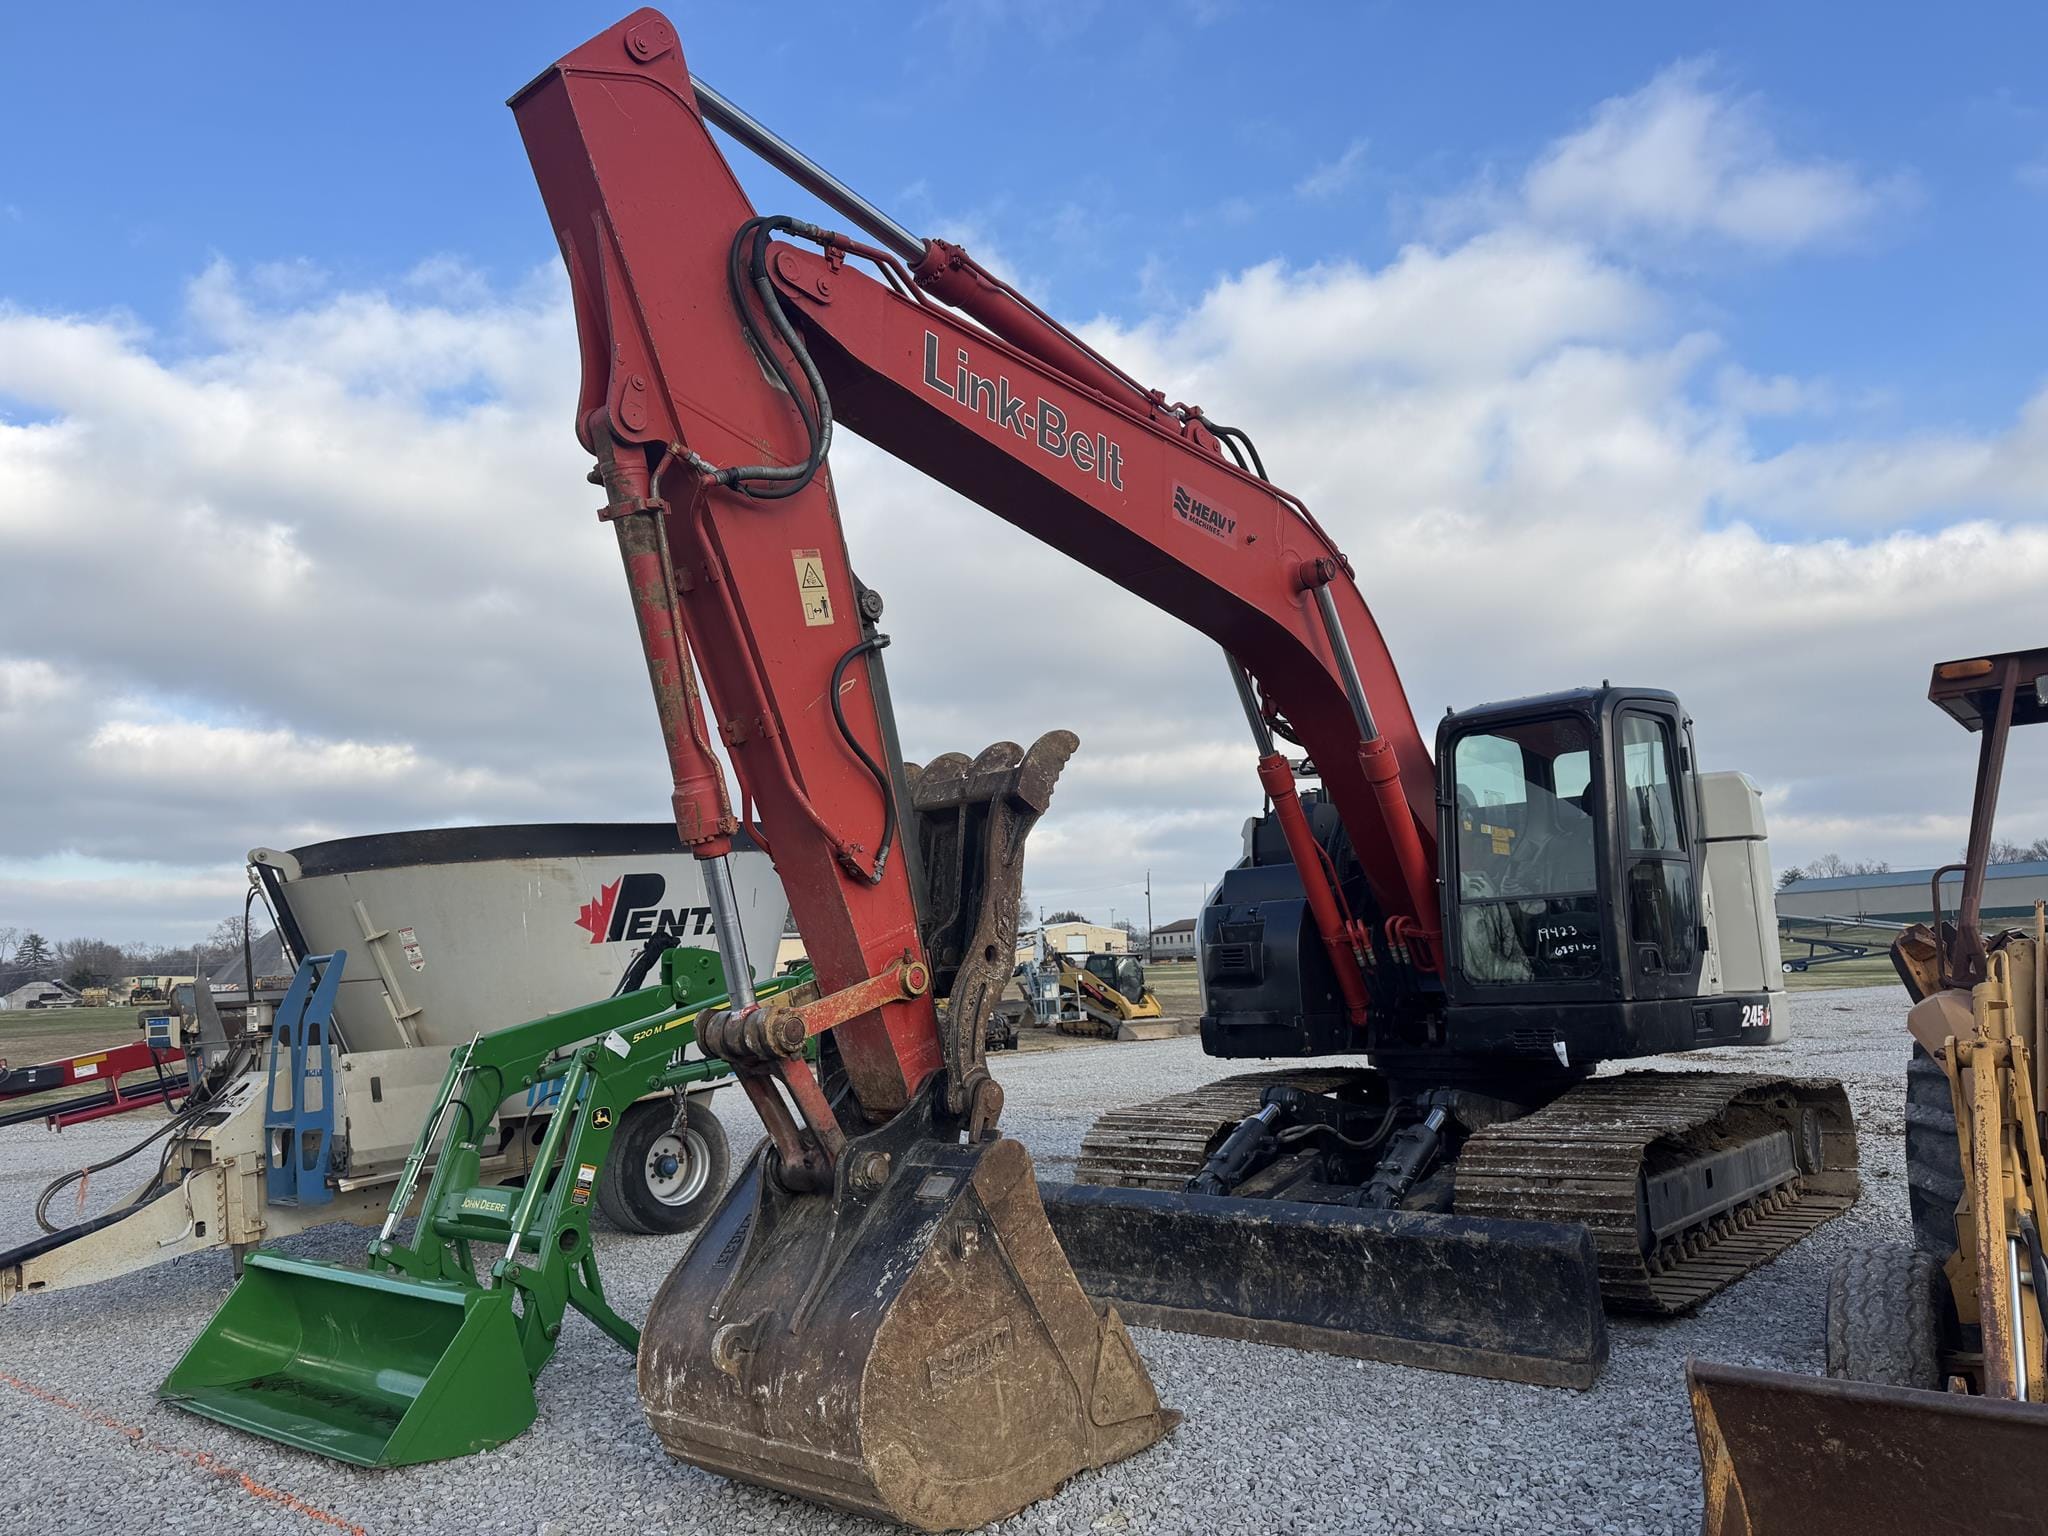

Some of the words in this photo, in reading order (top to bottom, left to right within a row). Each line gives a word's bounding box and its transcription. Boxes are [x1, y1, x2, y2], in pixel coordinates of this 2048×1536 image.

[923, 330, 1123, 491] Link-Belt
[1191, 499, 1236, 534] HEAVY
[606, 873, 716, 942] PENT
[1538, 925, 1577, 942] 19423
[632, 1028, 653, 1044] 520
[461, 1197, 481, 1209] JOHN
[480, 1199, 507, 1212] DEERE
